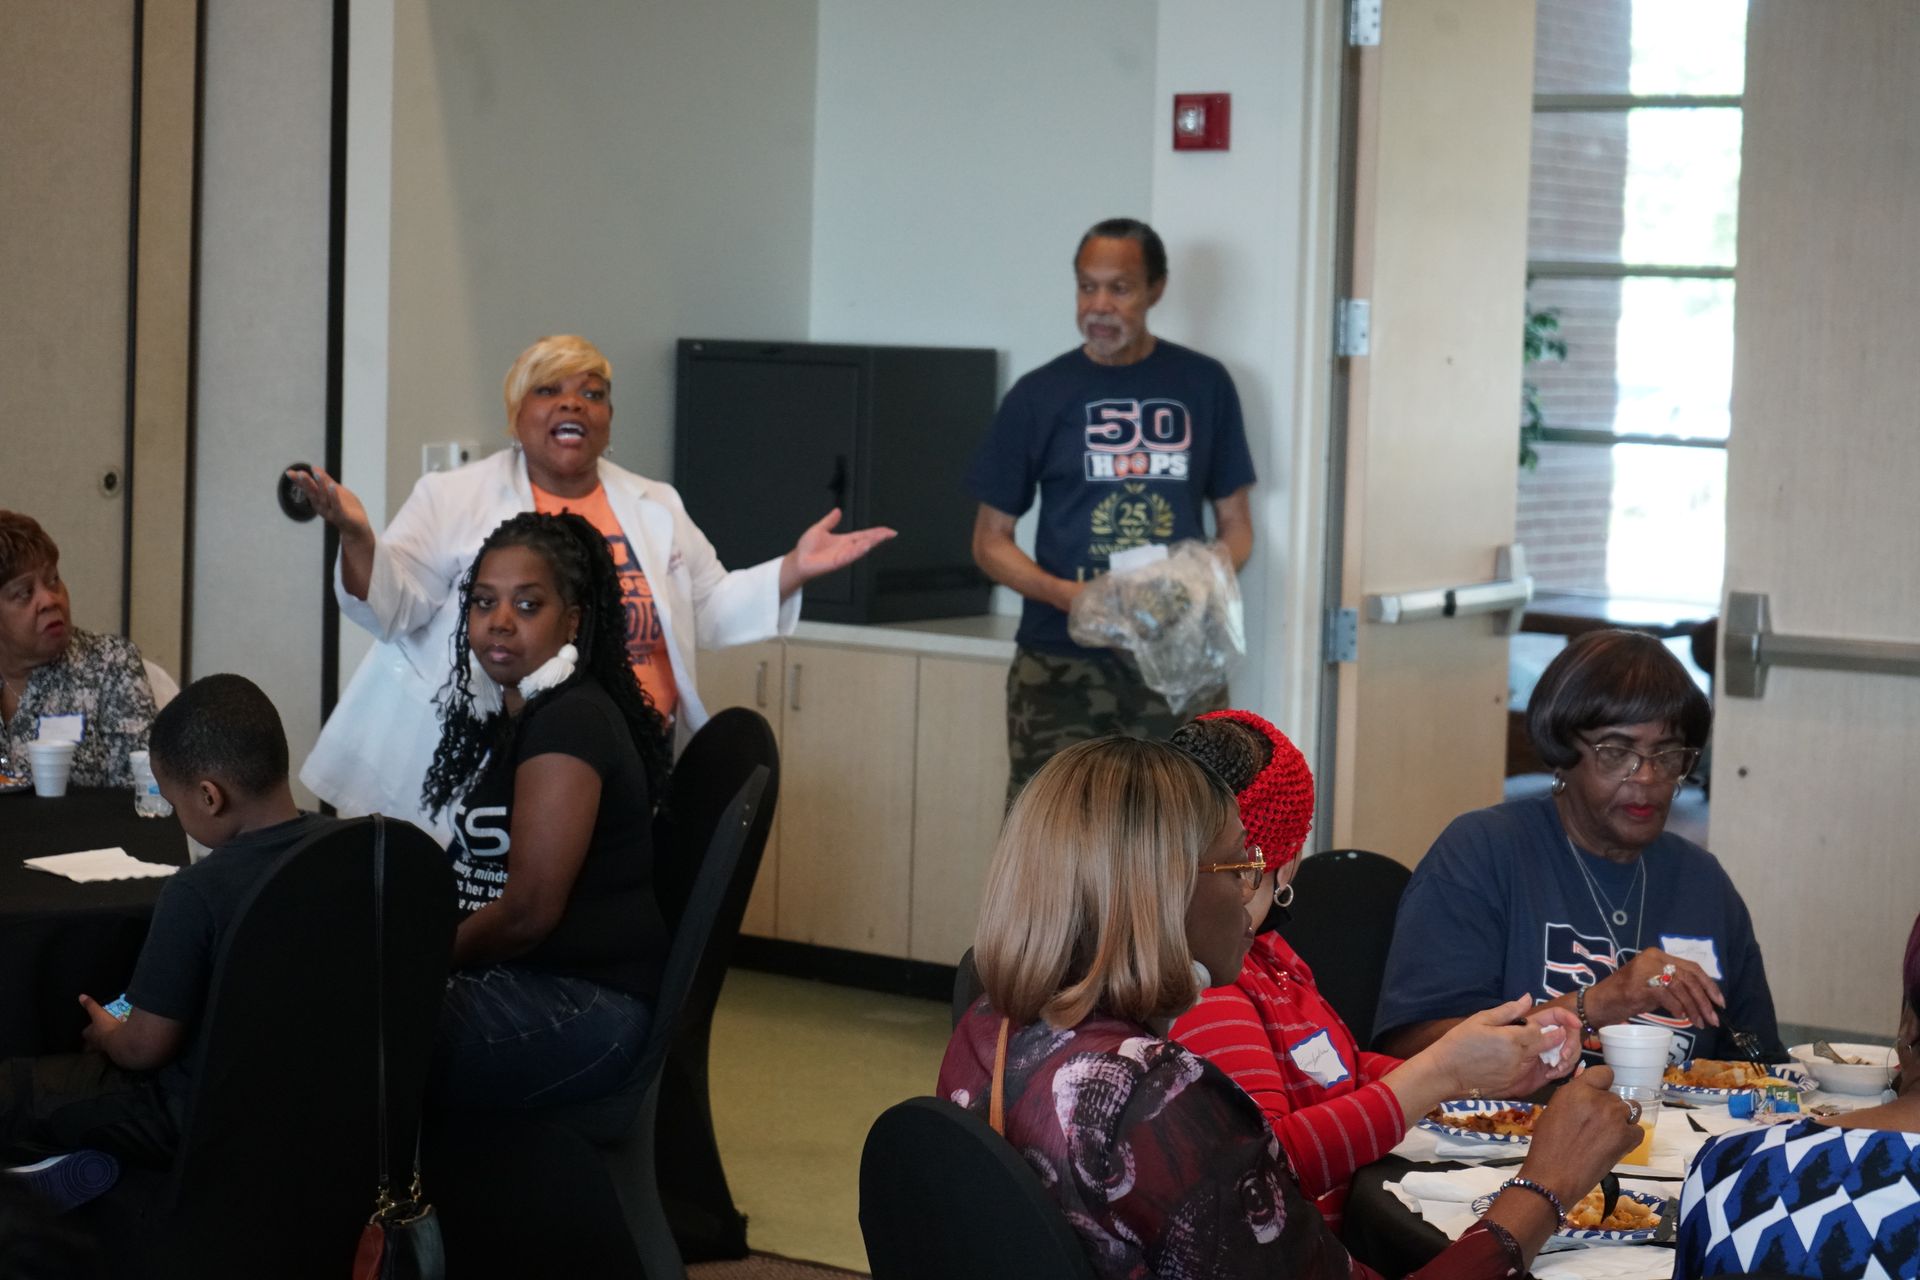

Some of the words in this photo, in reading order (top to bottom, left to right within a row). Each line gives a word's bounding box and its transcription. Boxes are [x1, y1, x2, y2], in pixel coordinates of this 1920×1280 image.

[1085, 398, 1192, 452] 50
[1090, 451, 1189, 478] HOOPS
[1119, 502, 1148, 526] 25
[465, 880, 485, 896] her
[474, 868, 509, 884] minds
